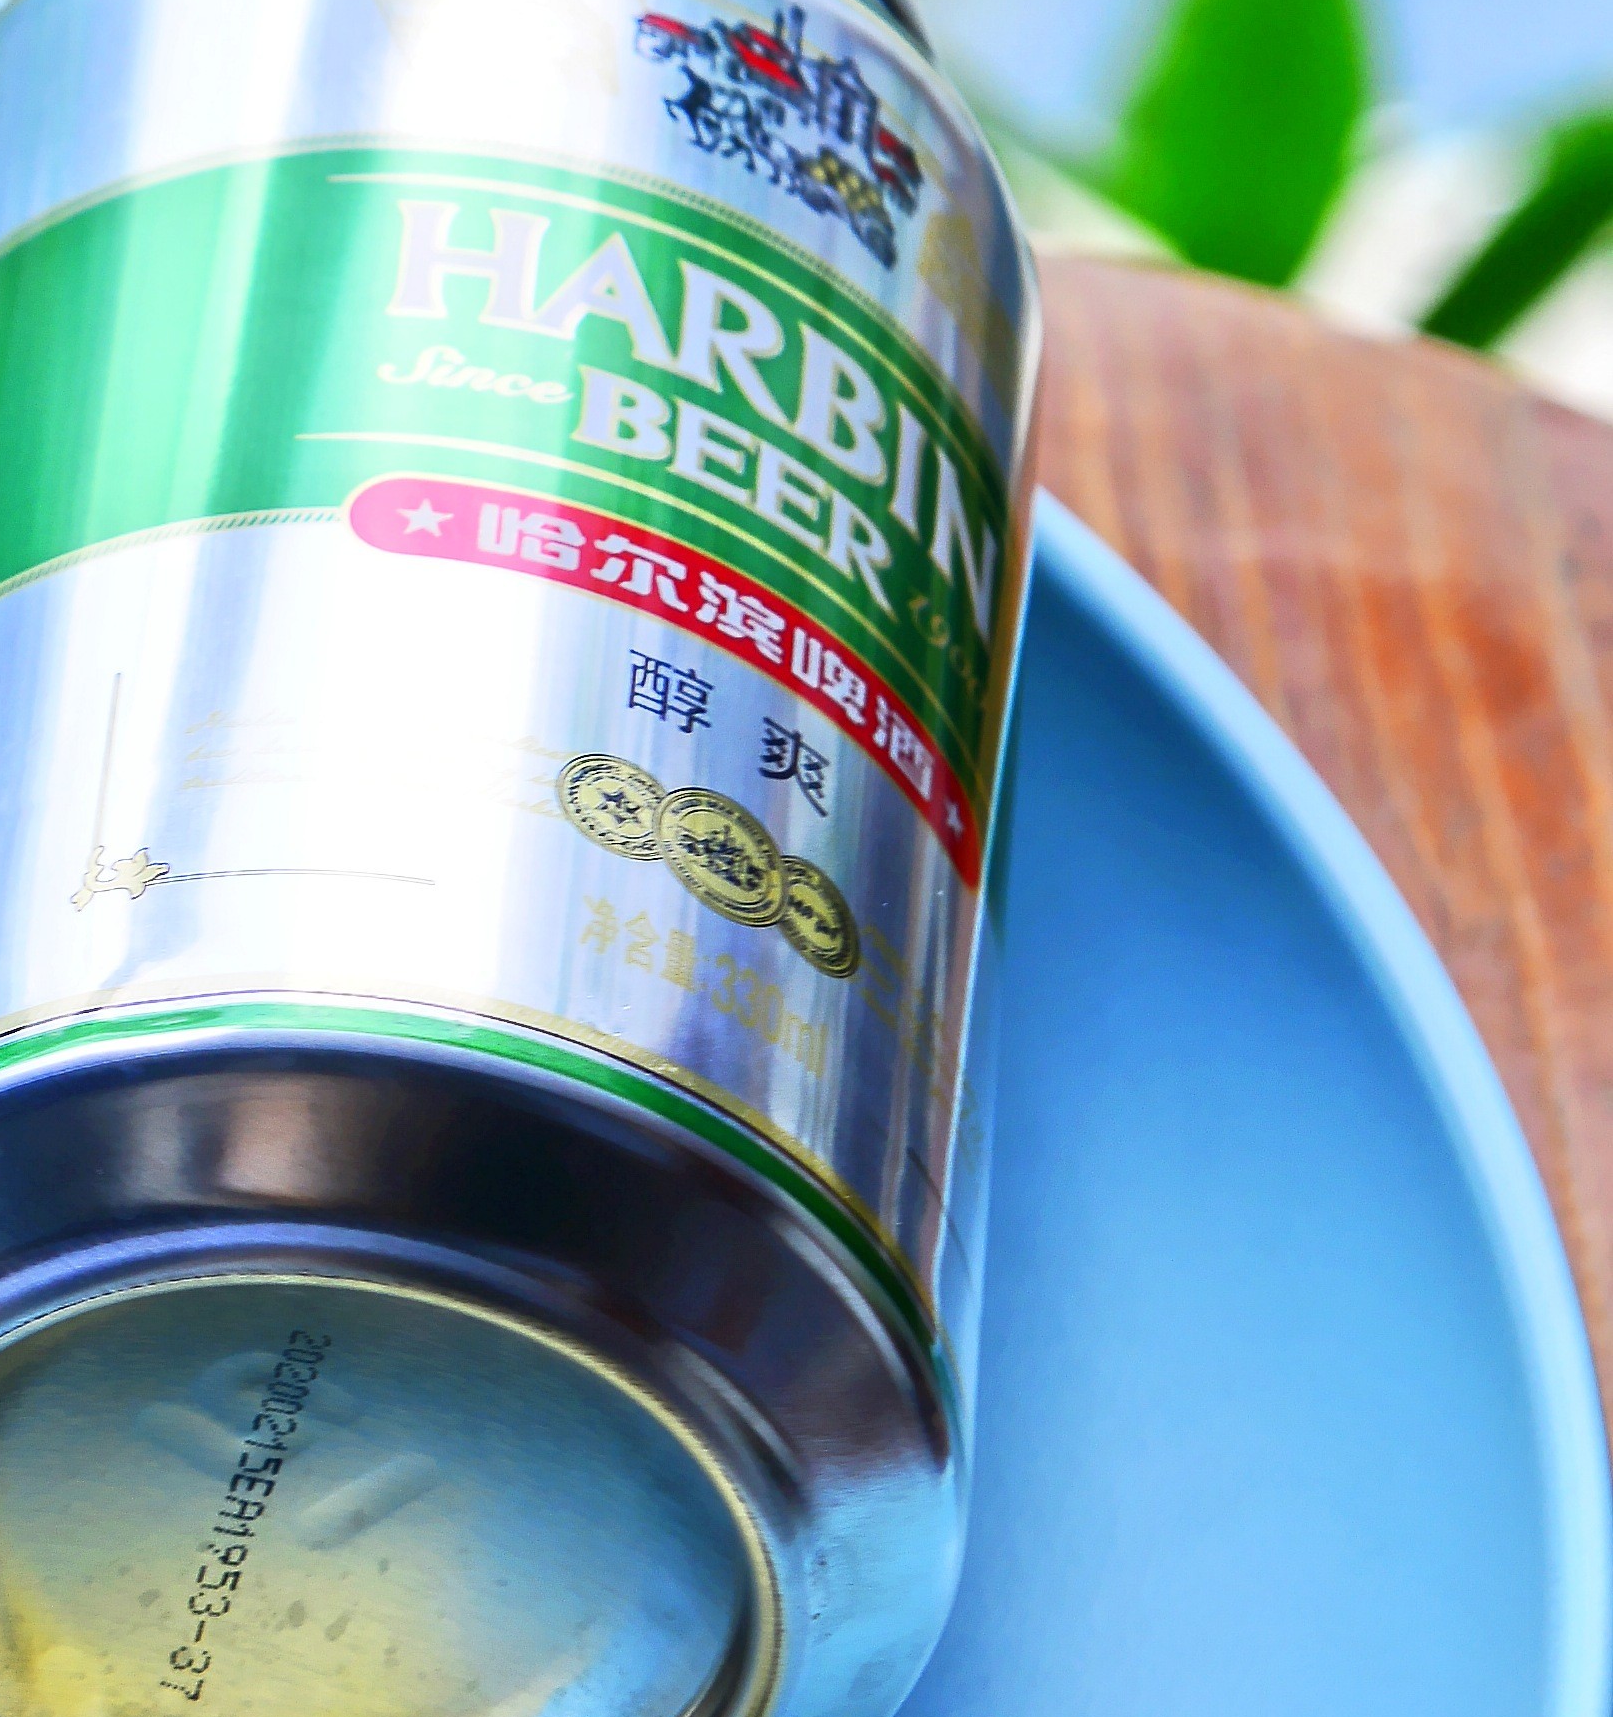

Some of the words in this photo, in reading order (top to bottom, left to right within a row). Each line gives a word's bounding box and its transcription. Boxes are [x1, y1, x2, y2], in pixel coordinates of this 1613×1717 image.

[377, 345, 574, 404] Since
[385, 199, 997, 646] HARBIN
[573, 363, 898, 625] BEER
[478, 502, 933, 801] 哈尔滨啤酒
